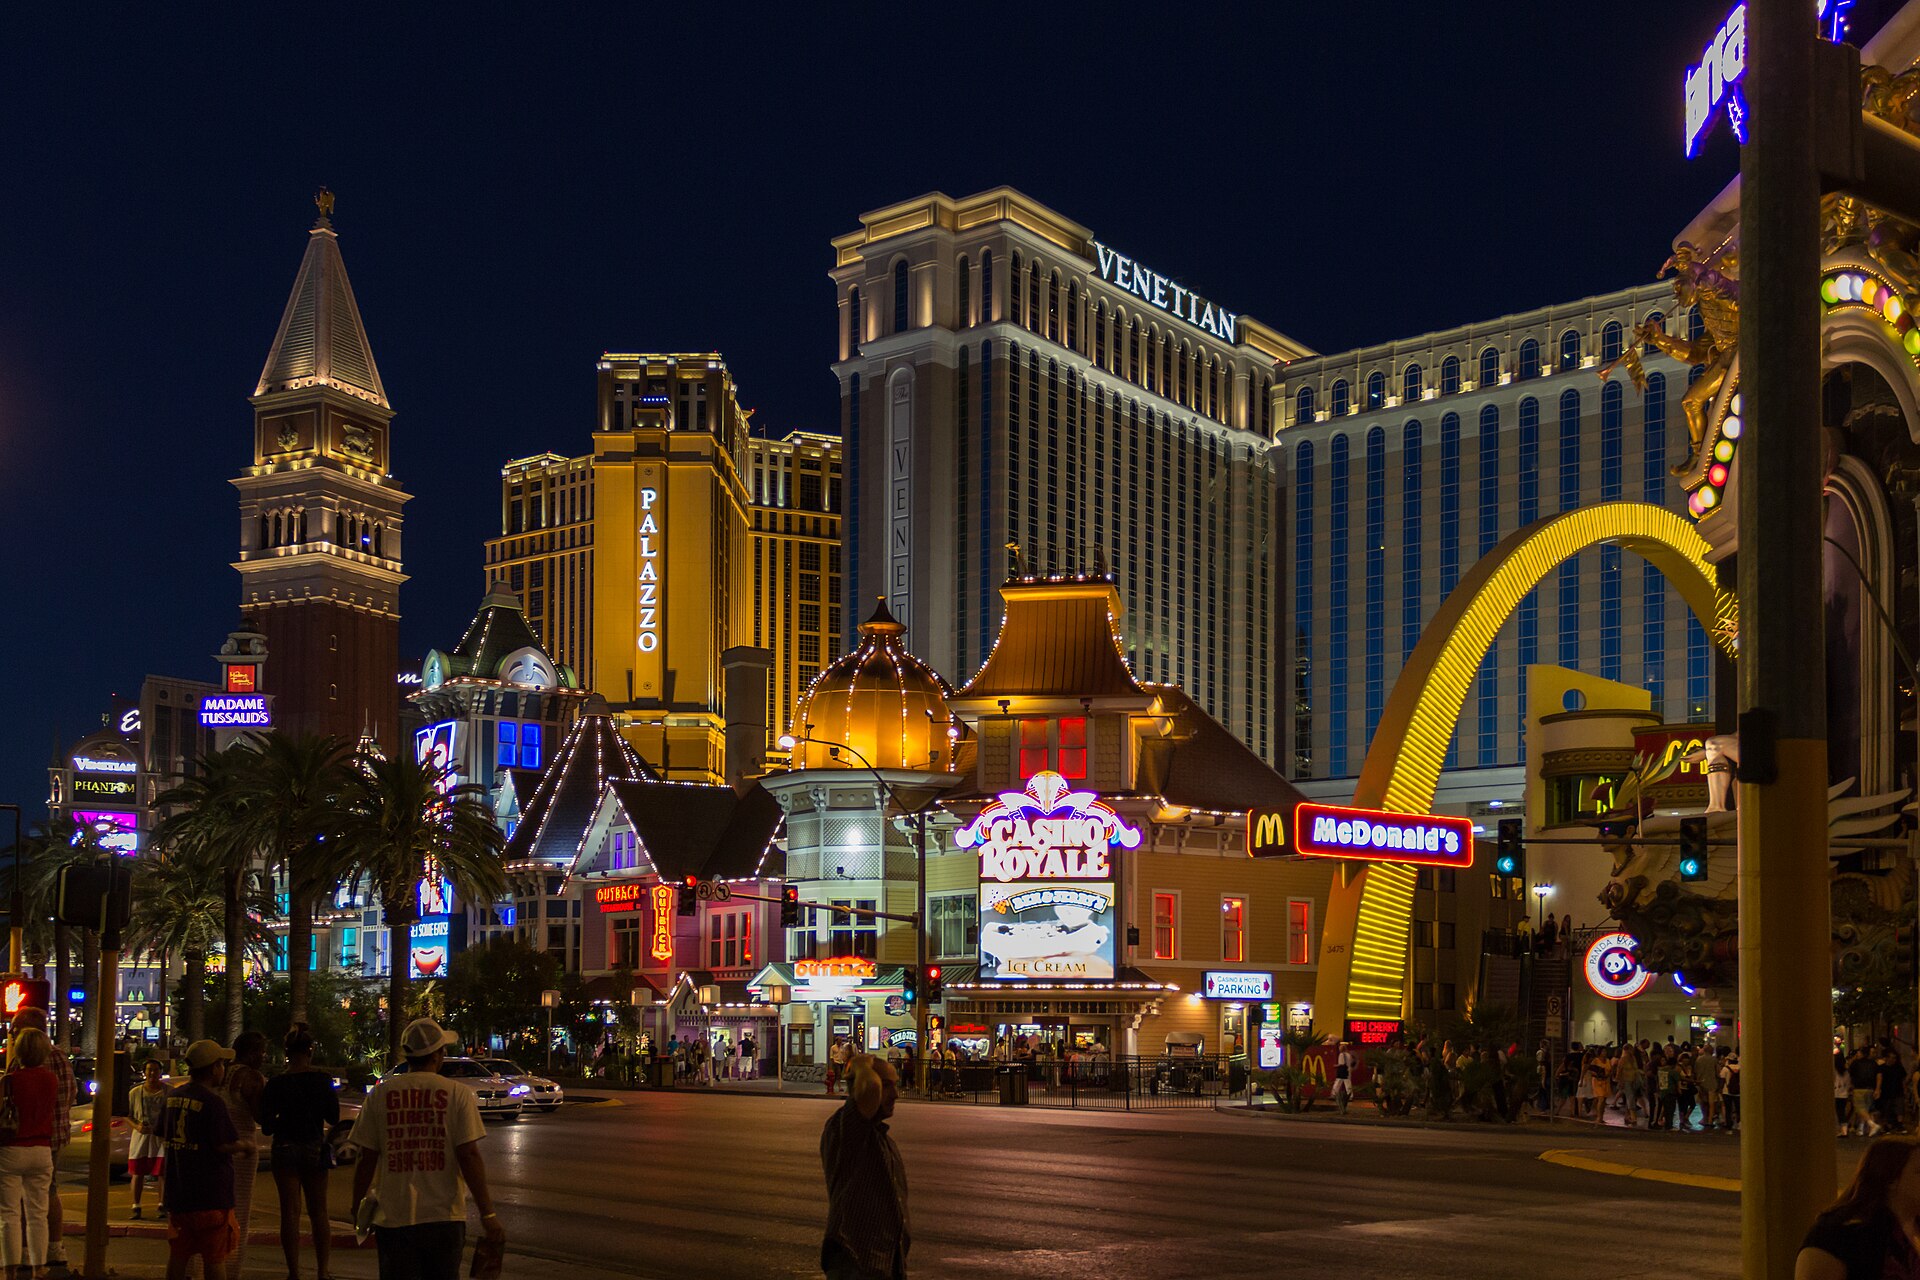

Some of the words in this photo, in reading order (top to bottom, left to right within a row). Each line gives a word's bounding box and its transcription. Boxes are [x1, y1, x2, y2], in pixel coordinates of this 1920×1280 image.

[1094, 241, 1236, 344] VENETIAN
[638, 489, 659, 652] PALAZZO
[204, 698, 265, 711] MADAME
[200, 710, 269, 724] TUSSAUD'S
[73, 757, 137, 773] VENETIAN
[74, 781, 135, 794] PHANTOM
[990, 818, 1105, 850] CASINO
[1313, 817, 1459, 853] McDonald's
[978, 839, 1110, 882] ROYALE
[597, 884, 640, 903] OUTBACK
[658, 888, 668, 953] OUTBACK
[1327, 945, 1345, 954] 3475
[1589, 939, 1613, 965] PANDA
[796, 963, 875, 977] OUTBACK
[1008, 960, 1027, 972] ICE
[1034, 960, 1087, 972] CREAM
[1218, 984, 1261, 994] PARKING
[1350, 1021, 1368, 1033] NEW
[1368, 1021, 1399, 1033] CHERRY
[1361, 1032, 1388, 1043] BERRY
[386, 1089, 448, 1110] GIRLS
[386, 1110, 447, 1126] DIRECT
[387, 1128, 404, 1139] TO
[409, 1126, 429, 1138] YOU
[431, 1127, 446, 1138] IN
[403, 1139, 445, 1150] MINUTES
